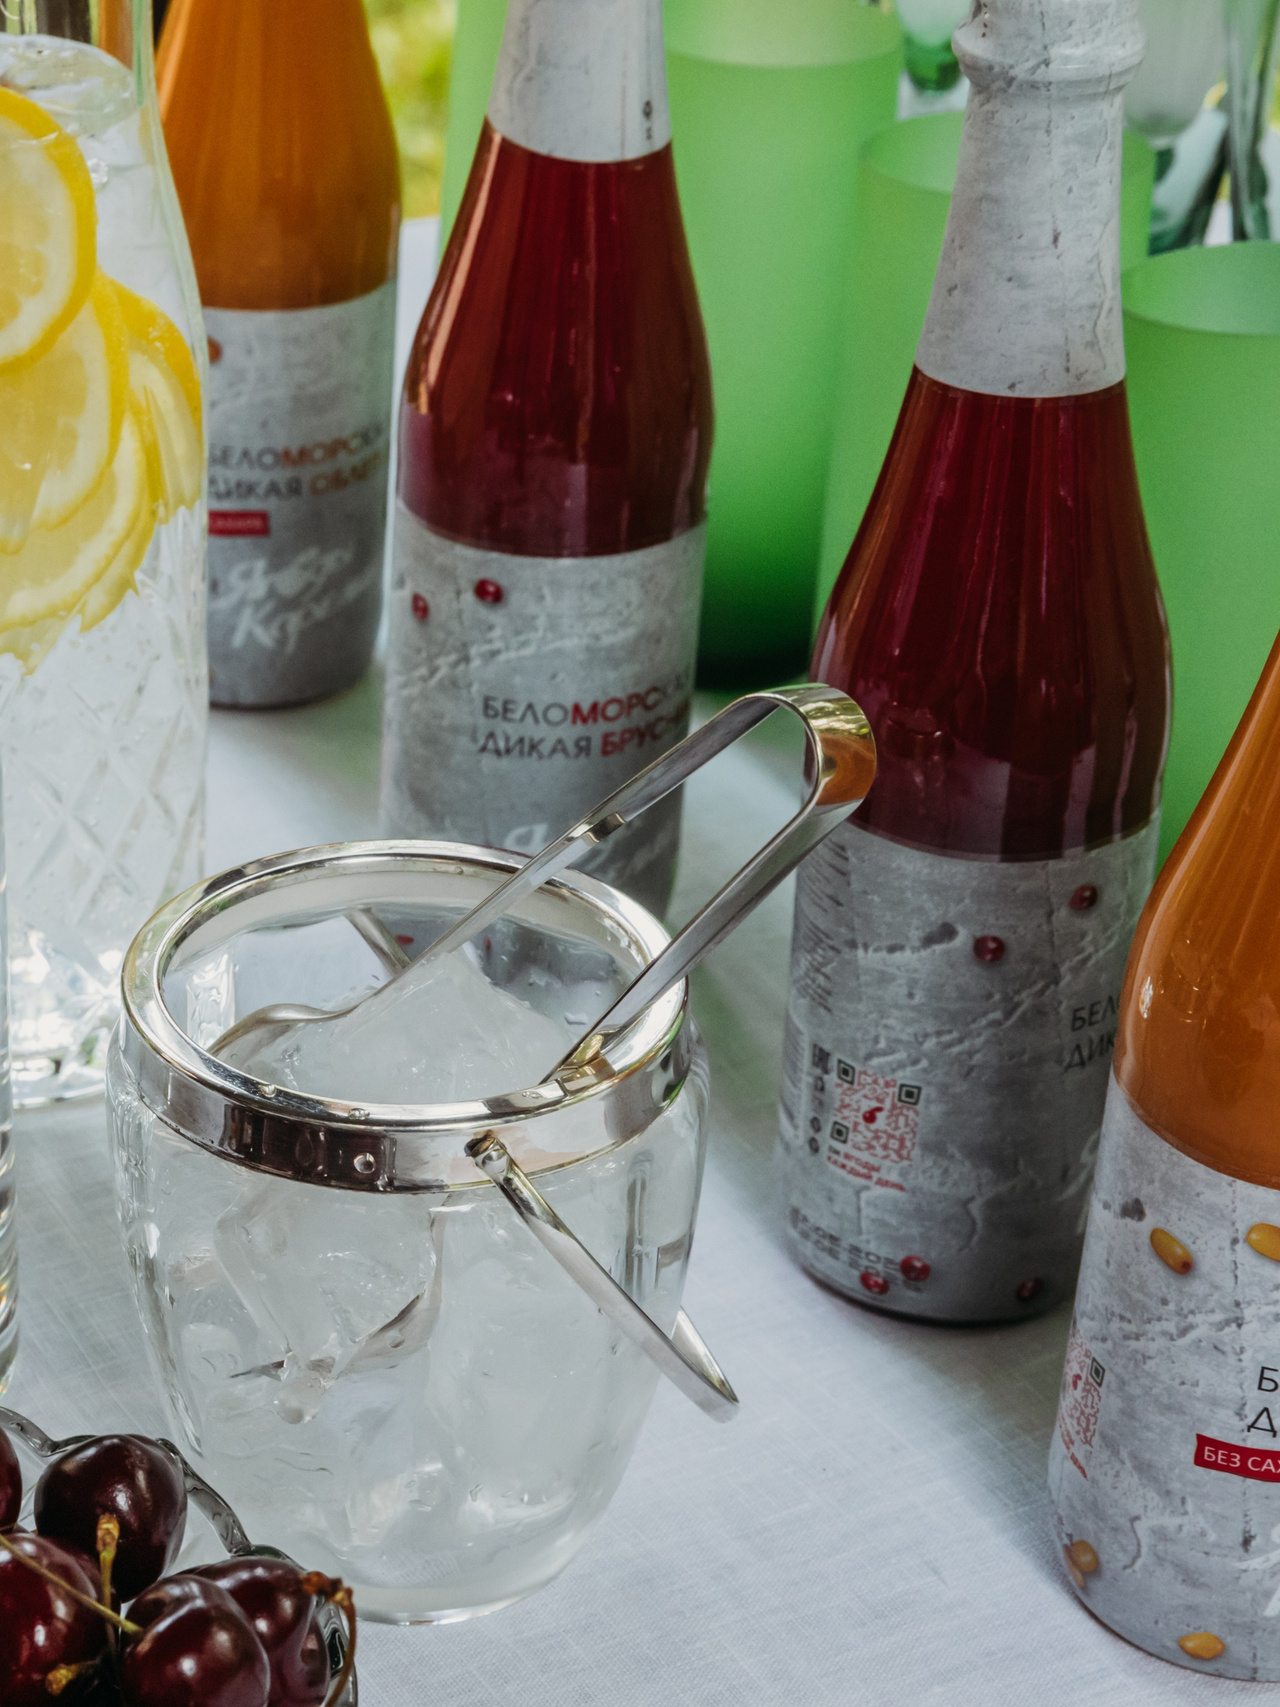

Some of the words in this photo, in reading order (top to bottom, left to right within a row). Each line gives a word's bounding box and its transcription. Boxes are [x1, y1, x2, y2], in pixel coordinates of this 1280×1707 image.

[482, 678, 682, 727] БЕЛОМОРС
[478, 730, 592, 760] ДИКАЯ
[1071, 995, 1120, 1032] БЕЛ
[1257, 1366, 1279, 1392] Б
[1246, 1406, 1278, 1438] Д
[1203, 1446, 1241, 1468] БЕЗ
